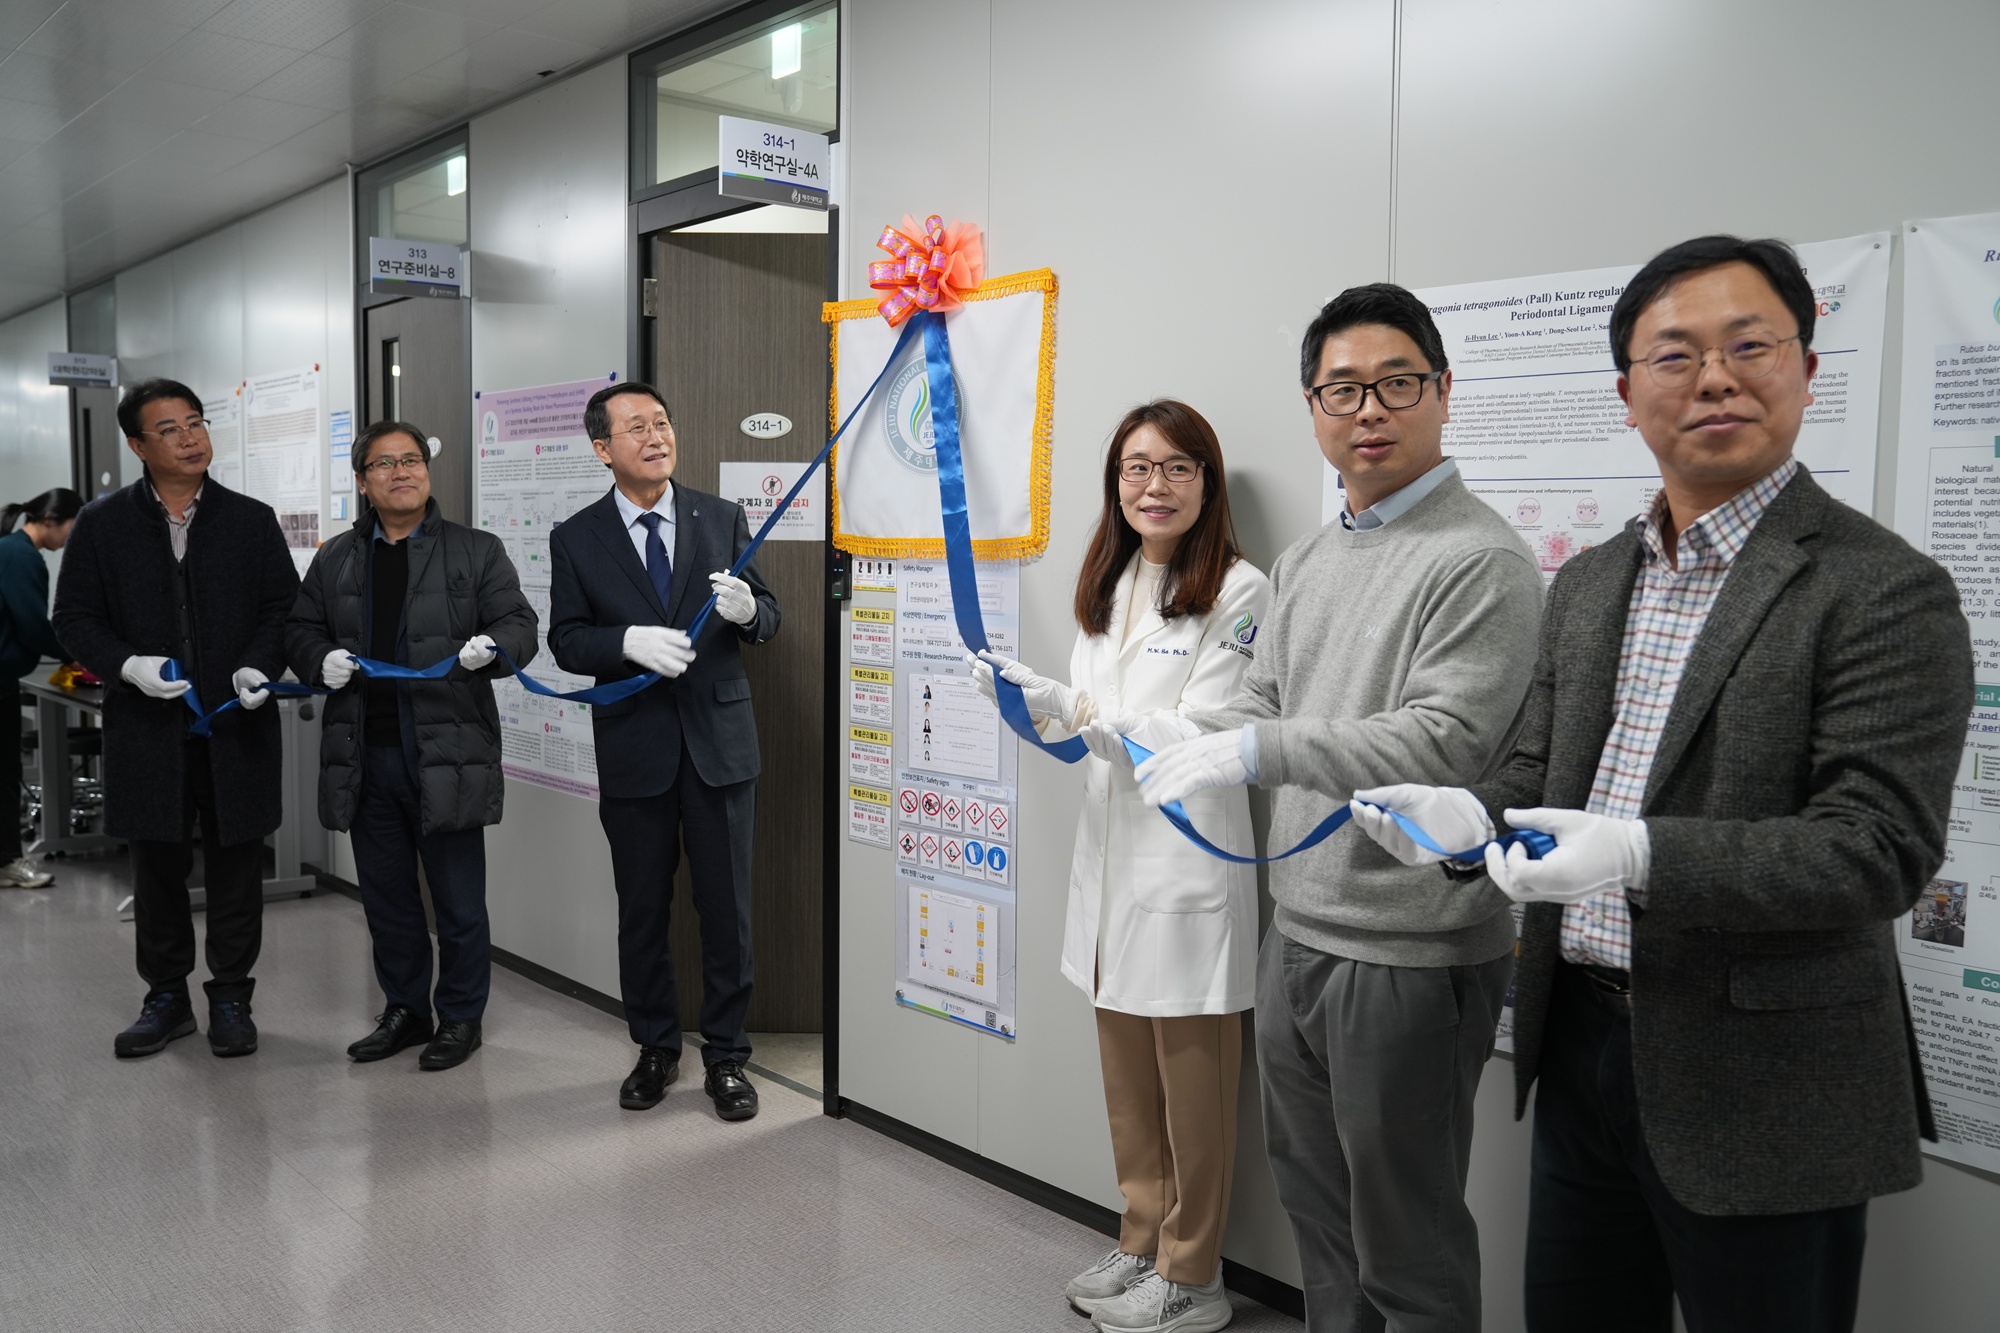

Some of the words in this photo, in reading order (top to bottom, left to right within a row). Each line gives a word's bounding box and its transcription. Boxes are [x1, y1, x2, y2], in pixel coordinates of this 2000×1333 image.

[763, 132, 794, 150] 314-1
[736, 148, 819, 180] 약학연구실-4A
[408, 248, 427, 259] 313
[378, 260, 455, 279] 연구준비실-8
[1427, 302, 1461, 316] tragonia
[1464, 297, 1523, 311] tetragonoides
[1525, 293, 1552, 306] (Pall)
[1555, 291, 1585, 302] Kuntz
[1588, 286, 1624, 300] regulat
[1511, 306, 1566, 320] Periodontal
[1570, 304, 1614, 317] Ligamen
[1549, 326, 1579, 334] Dong-Seol
[1960, 345, 1984, 353] Rubus
[1936, 369, 1971, 377] fractions
[889, 364, 922, 410] NATIONAL
[1812, 380, 1847, 388] Periodontal
[1935, 380, 1979, 388] mentioned
[1935, 392, 1984, 401] expressions
[1934, 402, 1966, 410] Further
[748, 420, 782, 432] 314-1
[889, 415, 899, 438] JEJU
[1934, 418, 1979, 427] Keywords:
[903, 447, 938, 468] 제주대
[1935, 476, 1977, 485] biological
[765, 498, 772, 507] 외
[776, 498, 809, 508] 출금지
[1934, 499, 1972, 507] potential
[1932, 521, 1988, 530] materials(1).
[1932, 531, 1978, 539] Rosaceae
[1931, 543, 1966, 551] species
[1958, 587, 1977, 596] only
[924, 613, 946, 621] Emergency
[1966, 610, 1986, 619] very
[1218, 641, 1238, 652] JEJU
[1973, 639, 2000, 648] study,
[1978, 712, 1997, 720] and
[879, 733, 888, 741] 고지
[926, 777, 939, 786] Safety
[939, 779, 950, 787] signs
[920, 872, 934, 881] Lay-out
[1981, 977, 2000, 988] Co
[1913, 983, 1934, 993] Aerial
[1940, 990, 1959, 999] parts
[1913, 995, 1945, 1007] potential.
[1912, 1004, 1926, 1013] The
[1930, 1010, 1957, 1022] extract,
[1962, 1016, 1974, 1025] EA
[1912, 1016, 1927, 1025] safe
[1945, 1023, 1964, 1033] RAW
[1968, 1029, 1991, 1039] 264.7
[1938, 1032, 1951, 1041] NO
[1953, 1037, 1995, 1052] production.
[1929, 1042, 1972, 1058] anti-oxidant
[1976, 1054, 1998, 1064] effect
[1932, 1054, 1945, 1062] and
[1971, 1064, 1997, 1075] mRNA
[1938, 1066, 1950, 1074] the
[1952, 1070, 1973, 1080] aerial
[1975, 1076, 1995, 1086] parts
[1966, 1085, 1981, 1093] and
[1163, 1296, 1193, 1318] HOKA
